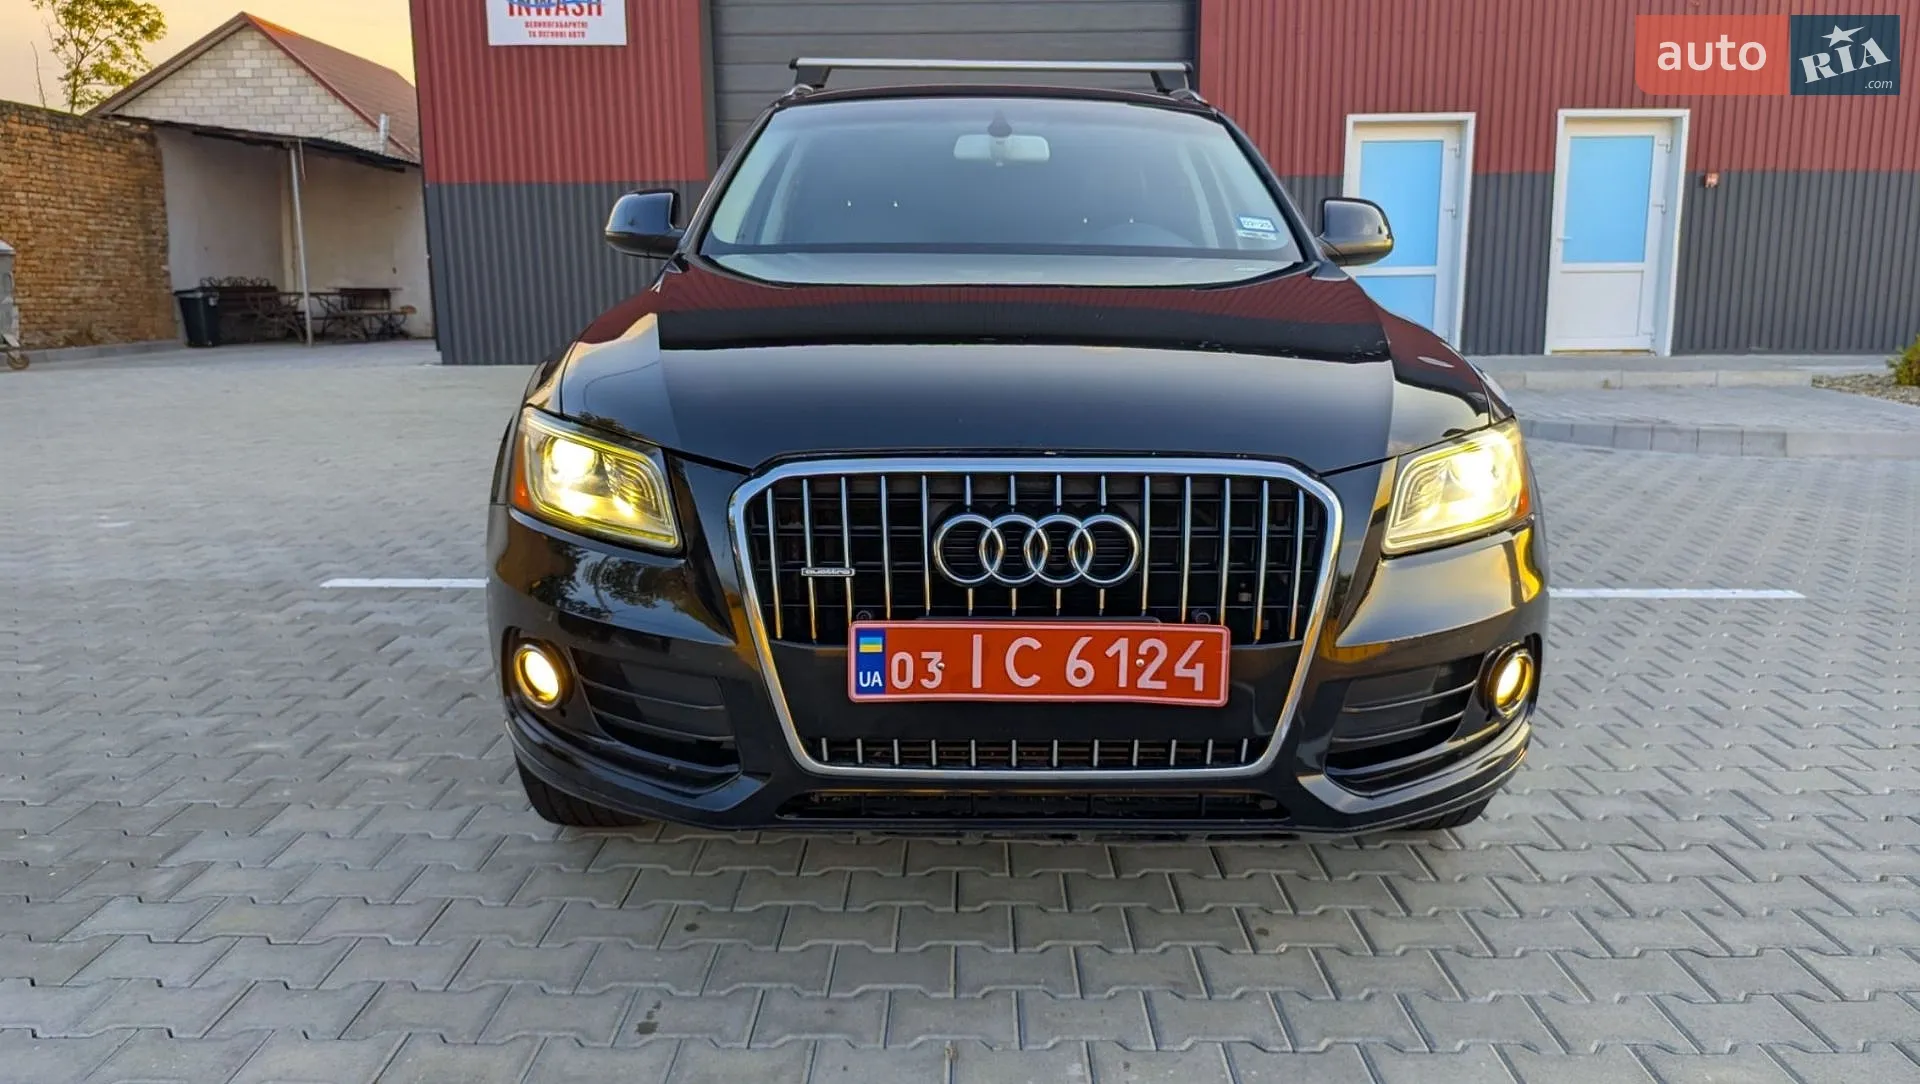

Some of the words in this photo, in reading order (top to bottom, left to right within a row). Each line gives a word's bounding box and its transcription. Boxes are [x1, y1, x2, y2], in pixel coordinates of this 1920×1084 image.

[507, 0, 603, 17] INWASH
[890, 651, 943, 690] 03
[1065, 635, 1205, 692] 6124
[858, 671, 884, 687] UA
